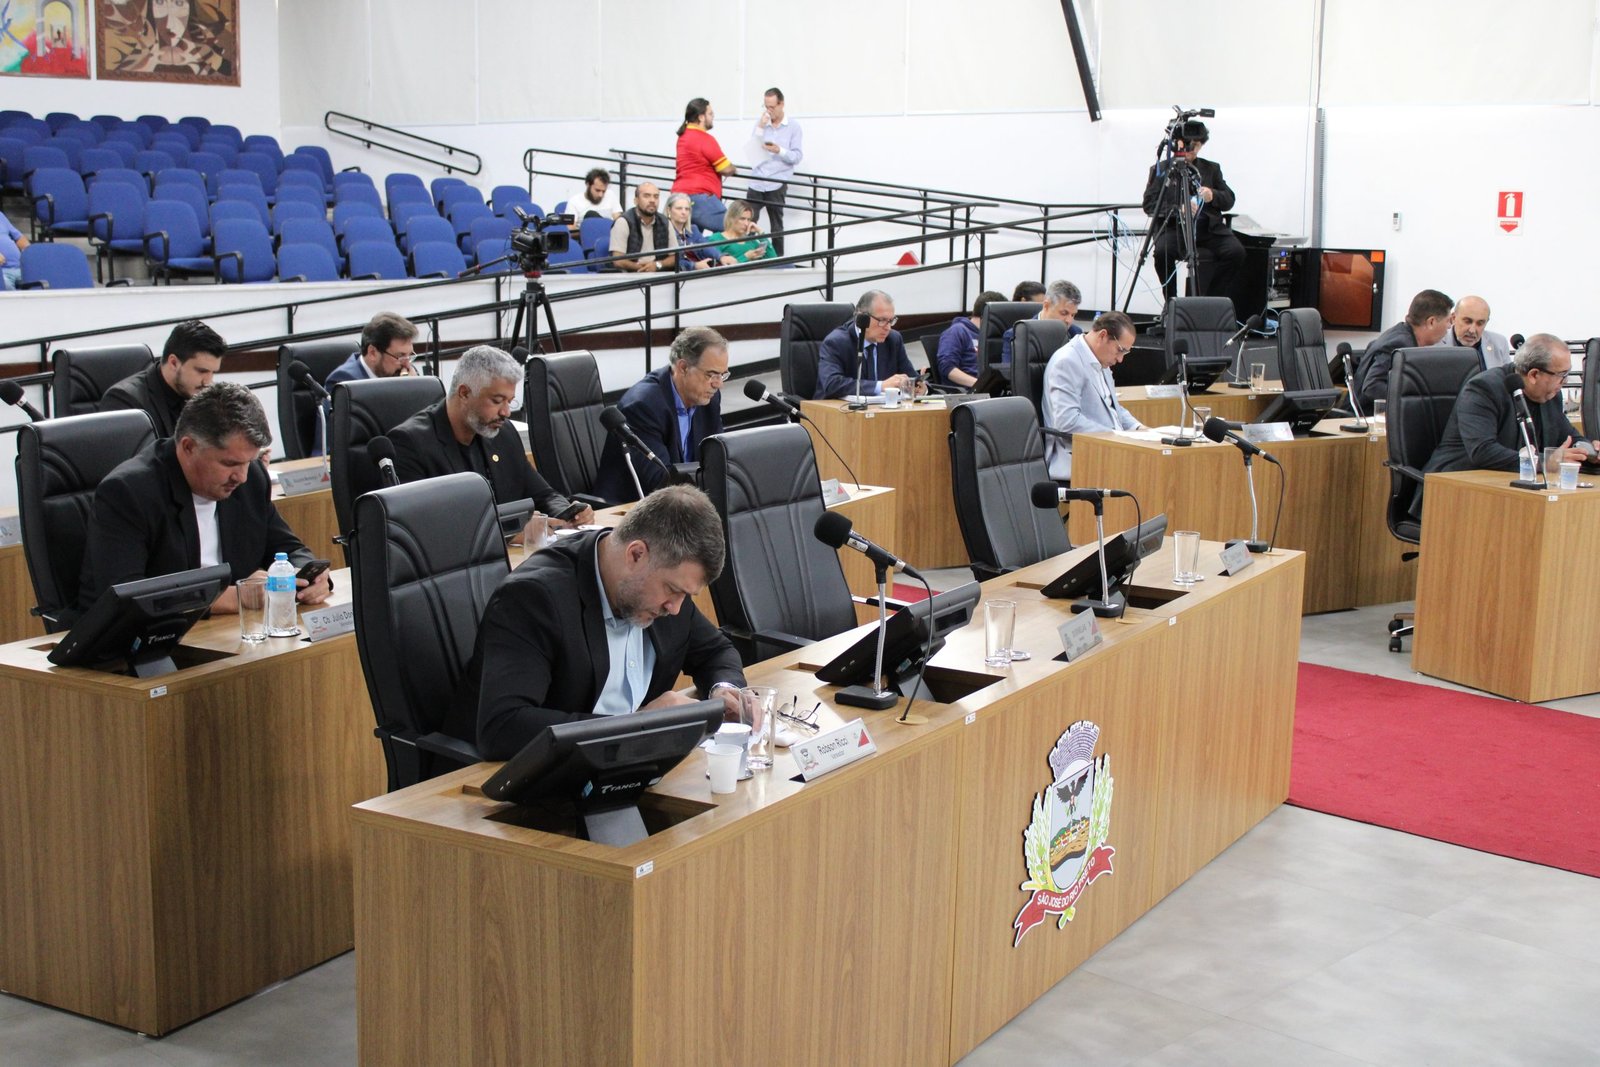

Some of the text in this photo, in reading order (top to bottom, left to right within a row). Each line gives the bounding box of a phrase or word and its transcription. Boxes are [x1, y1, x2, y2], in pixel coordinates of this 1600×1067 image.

[816, 735, 849, 756] Robson Ricci
[1037, 857, 1096, 909] SÃO JOSÉ DO RIO PRETO
